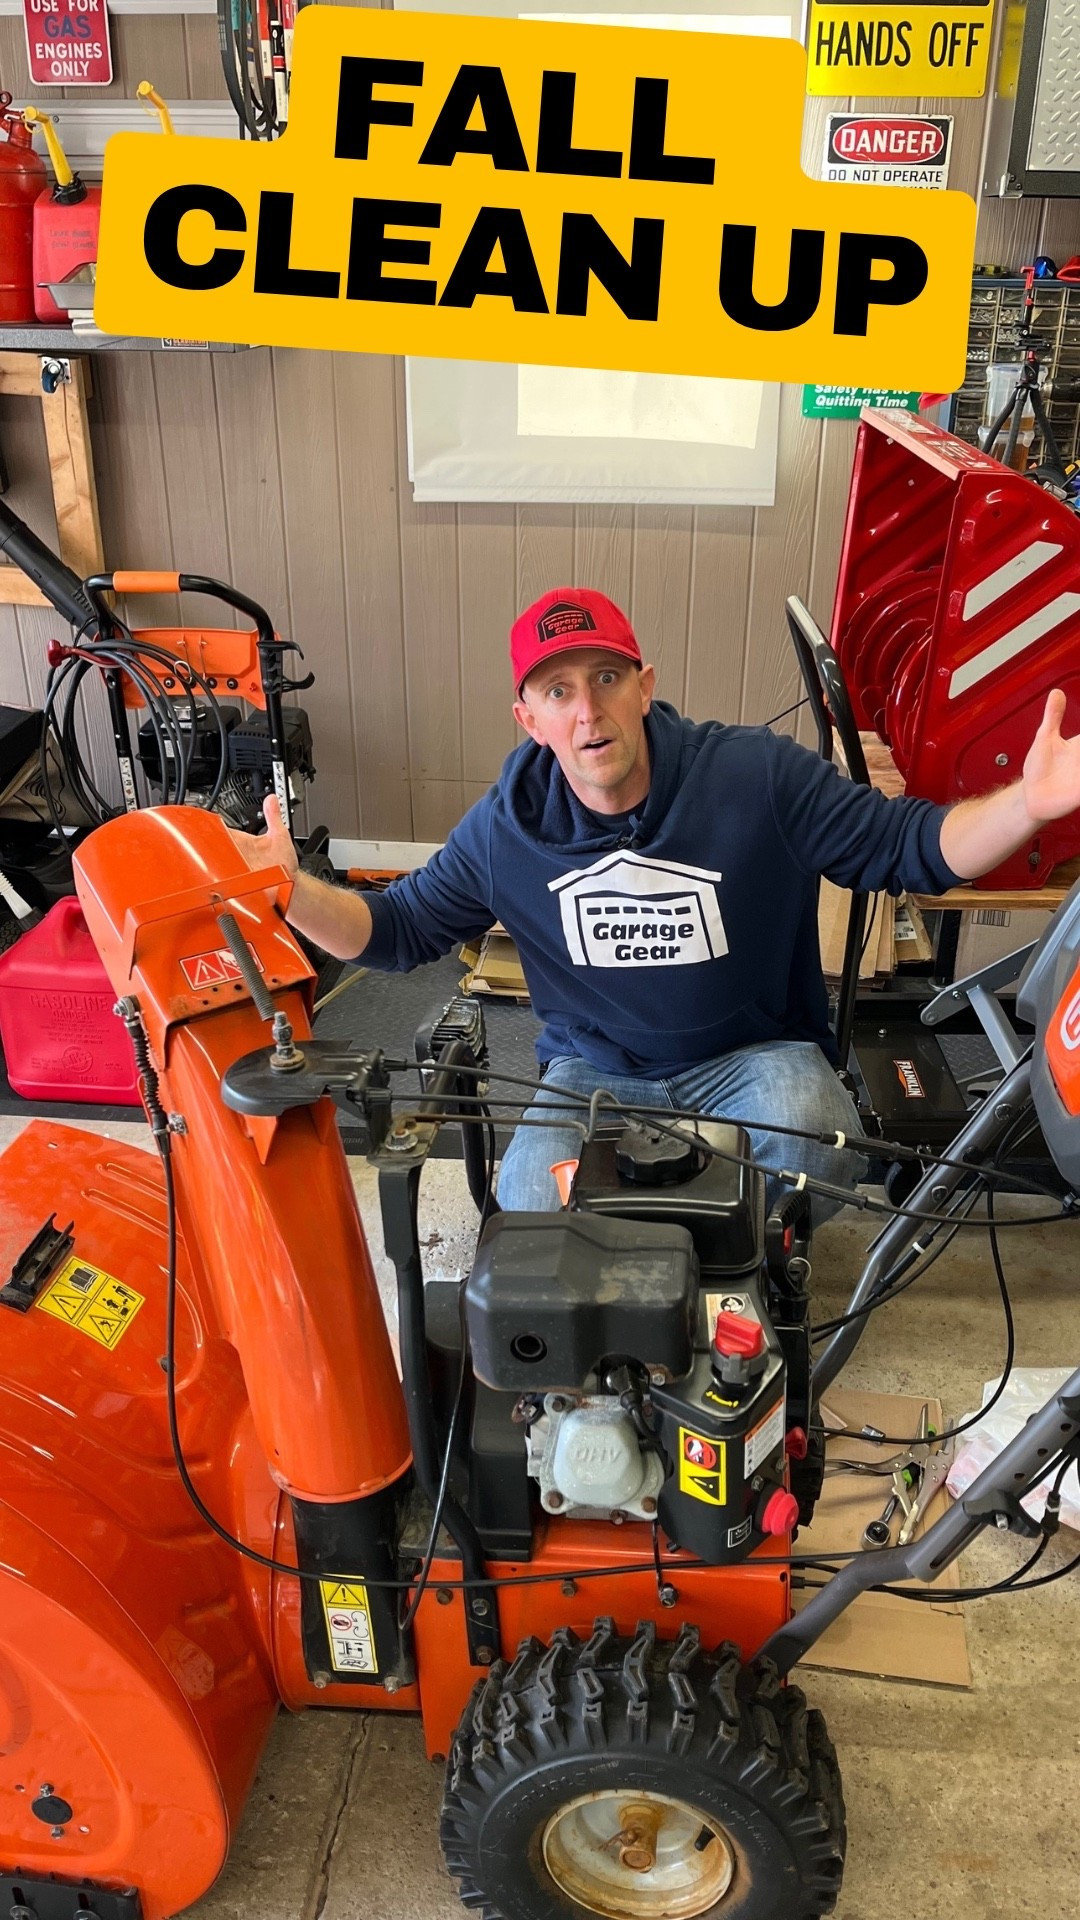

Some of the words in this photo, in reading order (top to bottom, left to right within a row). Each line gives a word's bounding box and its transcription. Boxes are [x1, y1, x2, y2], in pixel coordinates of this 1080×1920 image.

[30, 0, 59, 13] USE
[68, 0, 99, 12] FOR
[44, 14, 92, 39] GAS
[35, 42, 103, 59] ENGINES
[815, 20, 912, 67] HANDS
[928, 21, 985, 67] OFF
[50, 60, 90, 77] ONLY
[840, 127, 937, 155] DANGER
[828, 169, 847, 181] DO
[853, 169, 879, 182] NOT
[883, 170, 943, 183] OPERATE
[814, 384, 857, 396] Safety
[815, 394, 871, 408] Quitting
[875, 396, 909, 407] Time
[548, 617, 584, 631] Garage
[555, 624, 580, 634] Gear
[593, 922, 694, 942] Garage
[615, 944, 681, 961] Gear
[896, 1061, 923, 1096] FRANKLIN
